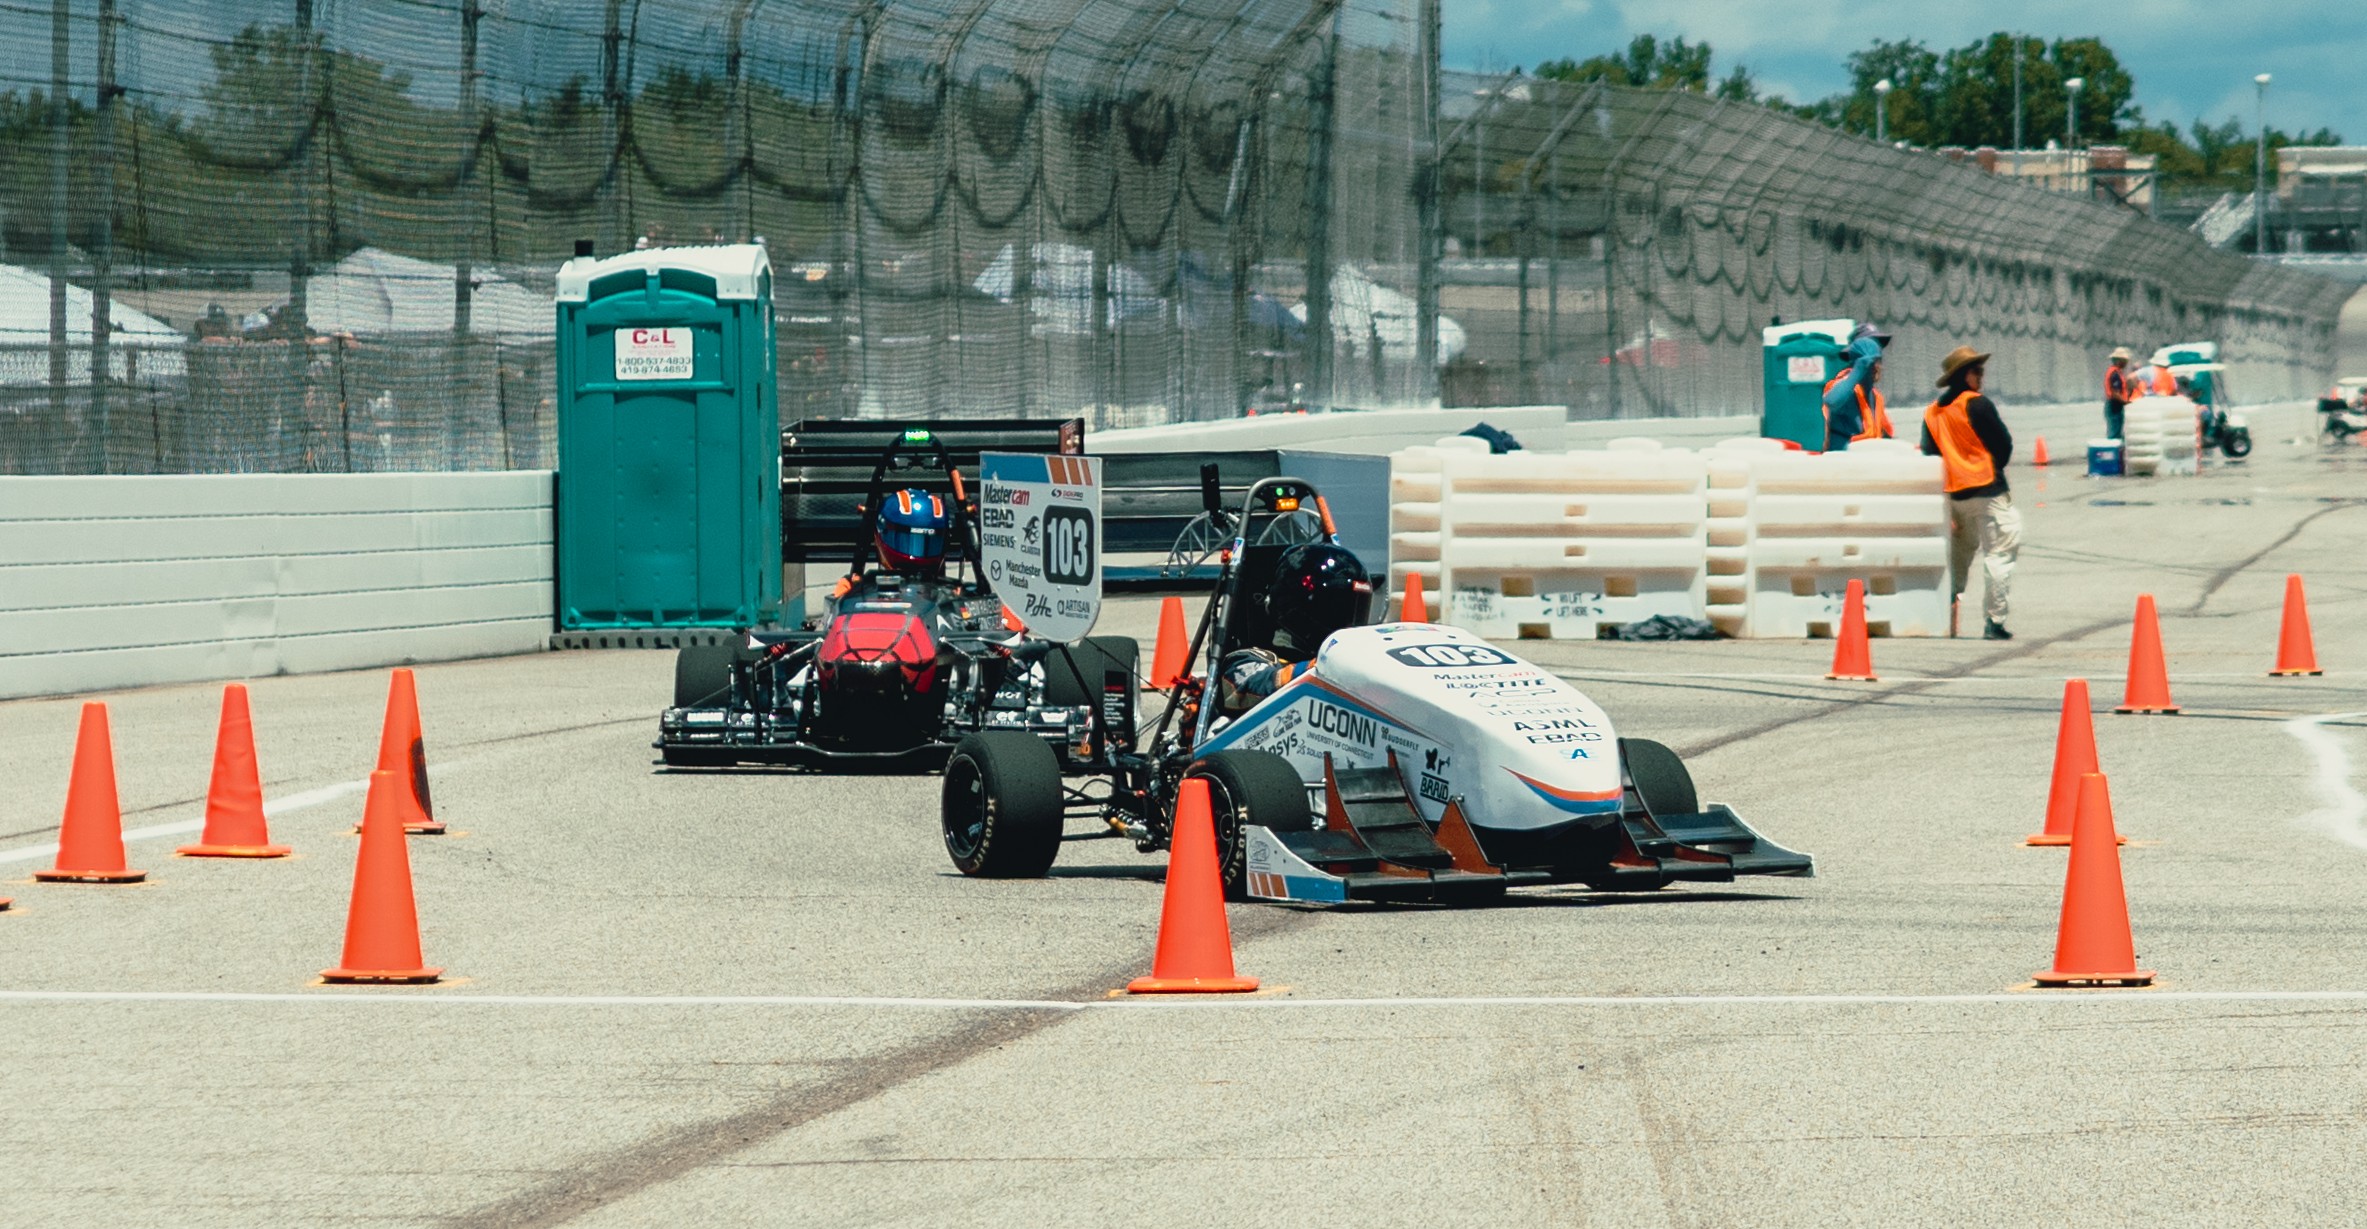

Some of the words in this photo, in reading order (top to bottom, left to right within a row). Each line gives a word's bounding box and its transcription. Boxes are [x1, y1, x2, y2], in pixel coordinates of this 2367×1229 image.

[983, 483, 1030, 506] Mastercam
[983, 533, 1015, 549] SIEMENS
[1047, 516, 1088, 577] 103
[1006, 559, 1041, 577] Manchester
[1009, 574, 1029, 590] Mazda
[1400, 645, 1503, 666] 103
[1434, 670, 1537, 681] Mastercam
[1308, 699, 1377, 748] UCONN
[1514, 718, 1598, 731] ASML
[1306, 730, 1335, 747] UNIVERSITY
[1334, 740, 1342, 748] OF
[1341, 743, 1375, 760] CONNECTICUT
[1421, 777, 1449, 800] BRAID
